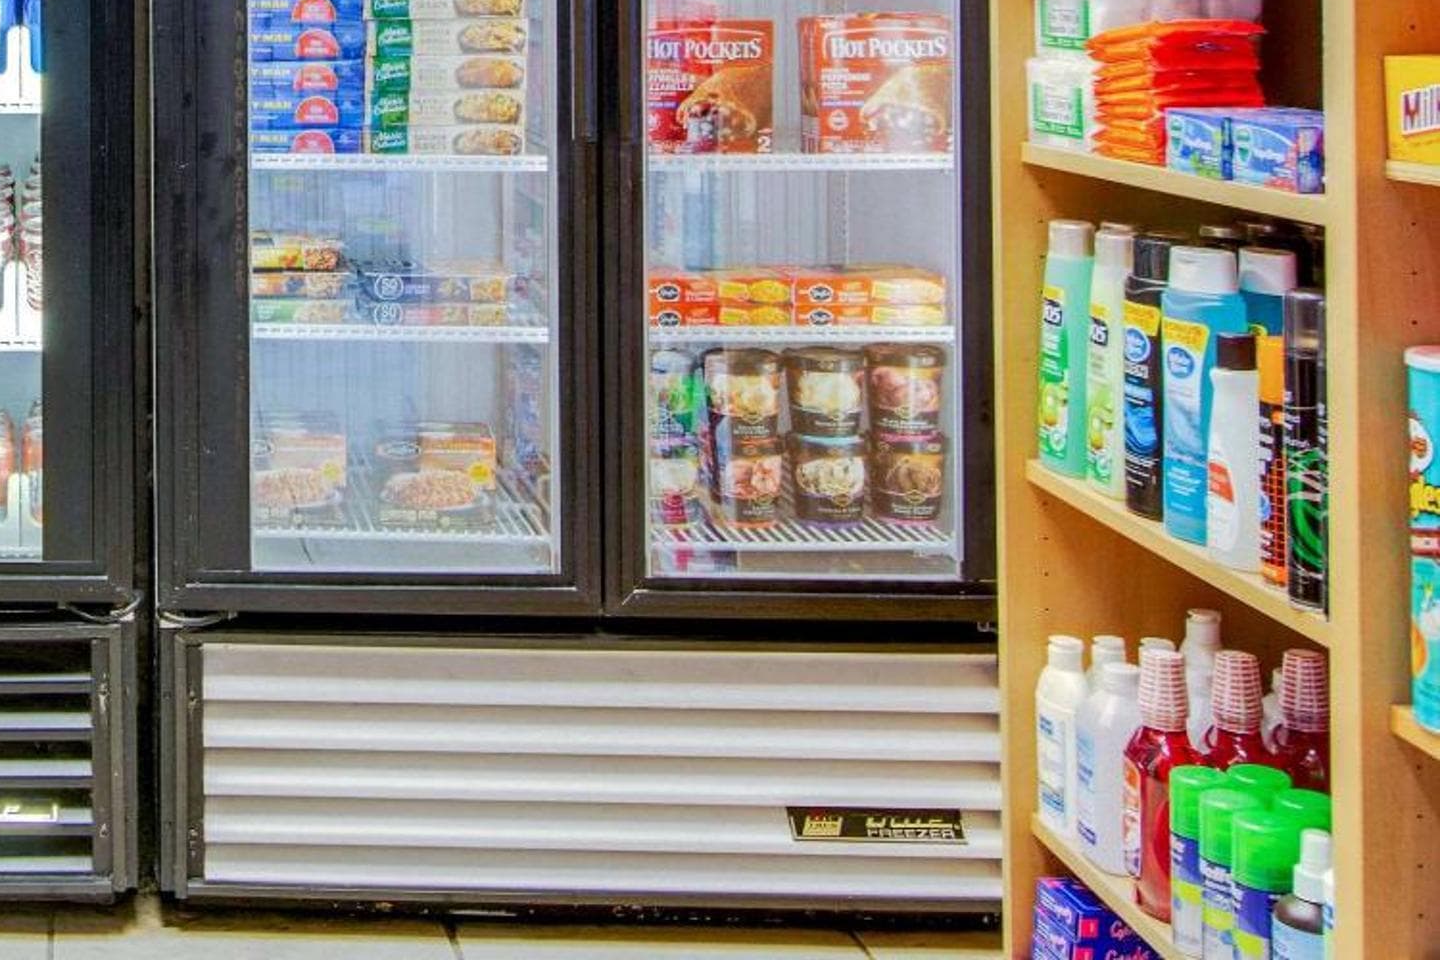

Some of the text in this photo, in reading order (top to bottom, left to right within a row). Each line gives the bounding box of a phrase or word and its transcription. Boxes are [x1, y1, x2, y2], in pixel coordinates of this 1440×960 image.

[647, 38, 760, 59] HOT POCKETS
[830, 36, 946, 59] HOT POCKETS
[758, 136, 771, 153] 2
[867, 828, 955, 839] FREEZER
